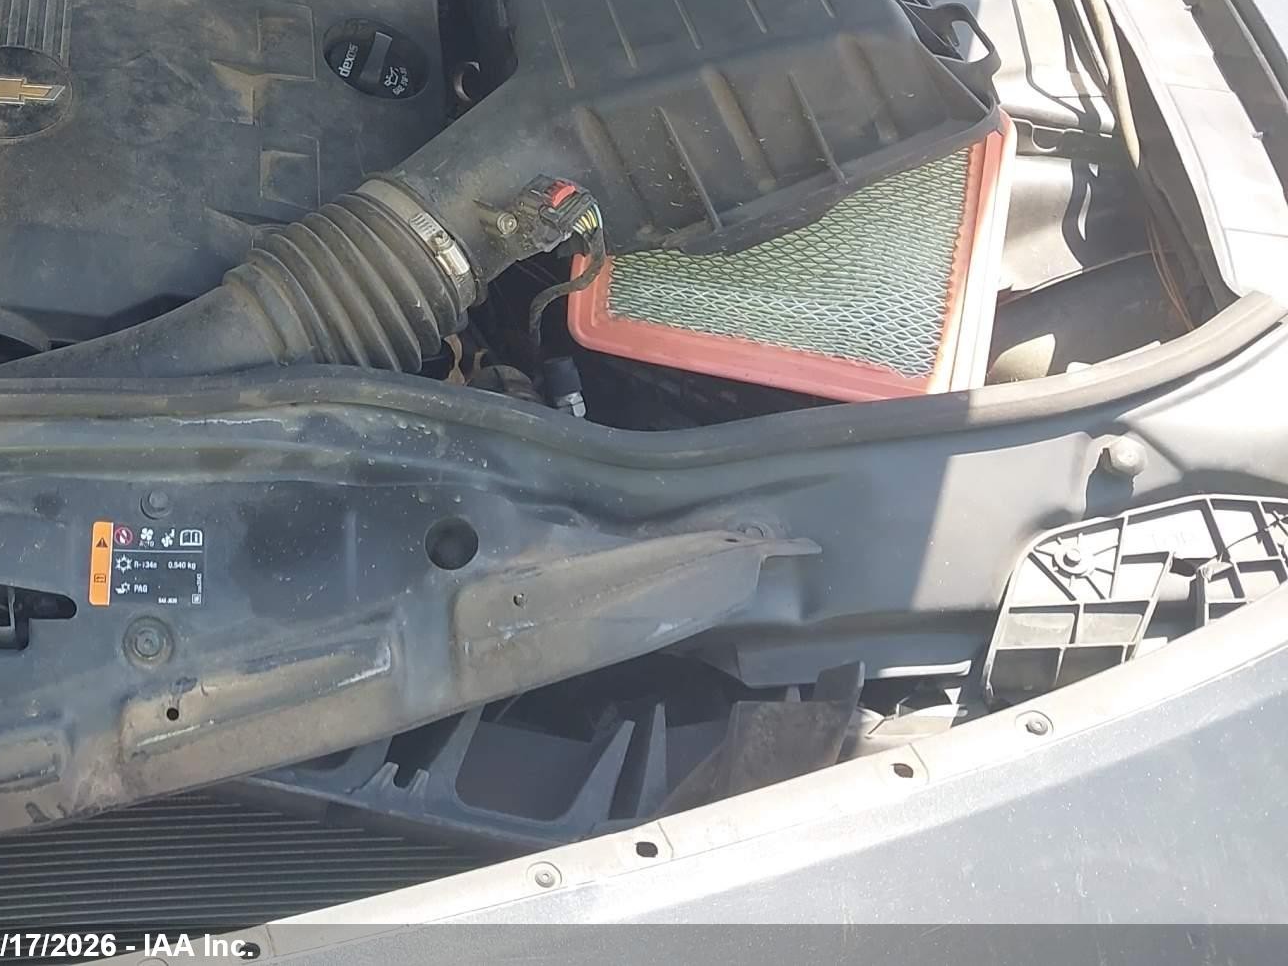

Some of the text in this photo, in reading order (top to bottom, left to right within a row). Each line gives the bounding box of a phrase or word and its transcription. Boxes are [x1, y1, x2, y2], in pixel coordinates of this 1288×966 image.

[338, 42, 359, 77] dexos
[187, 561, 197, 571] kg
[134, 584, 148, 593] PAG
